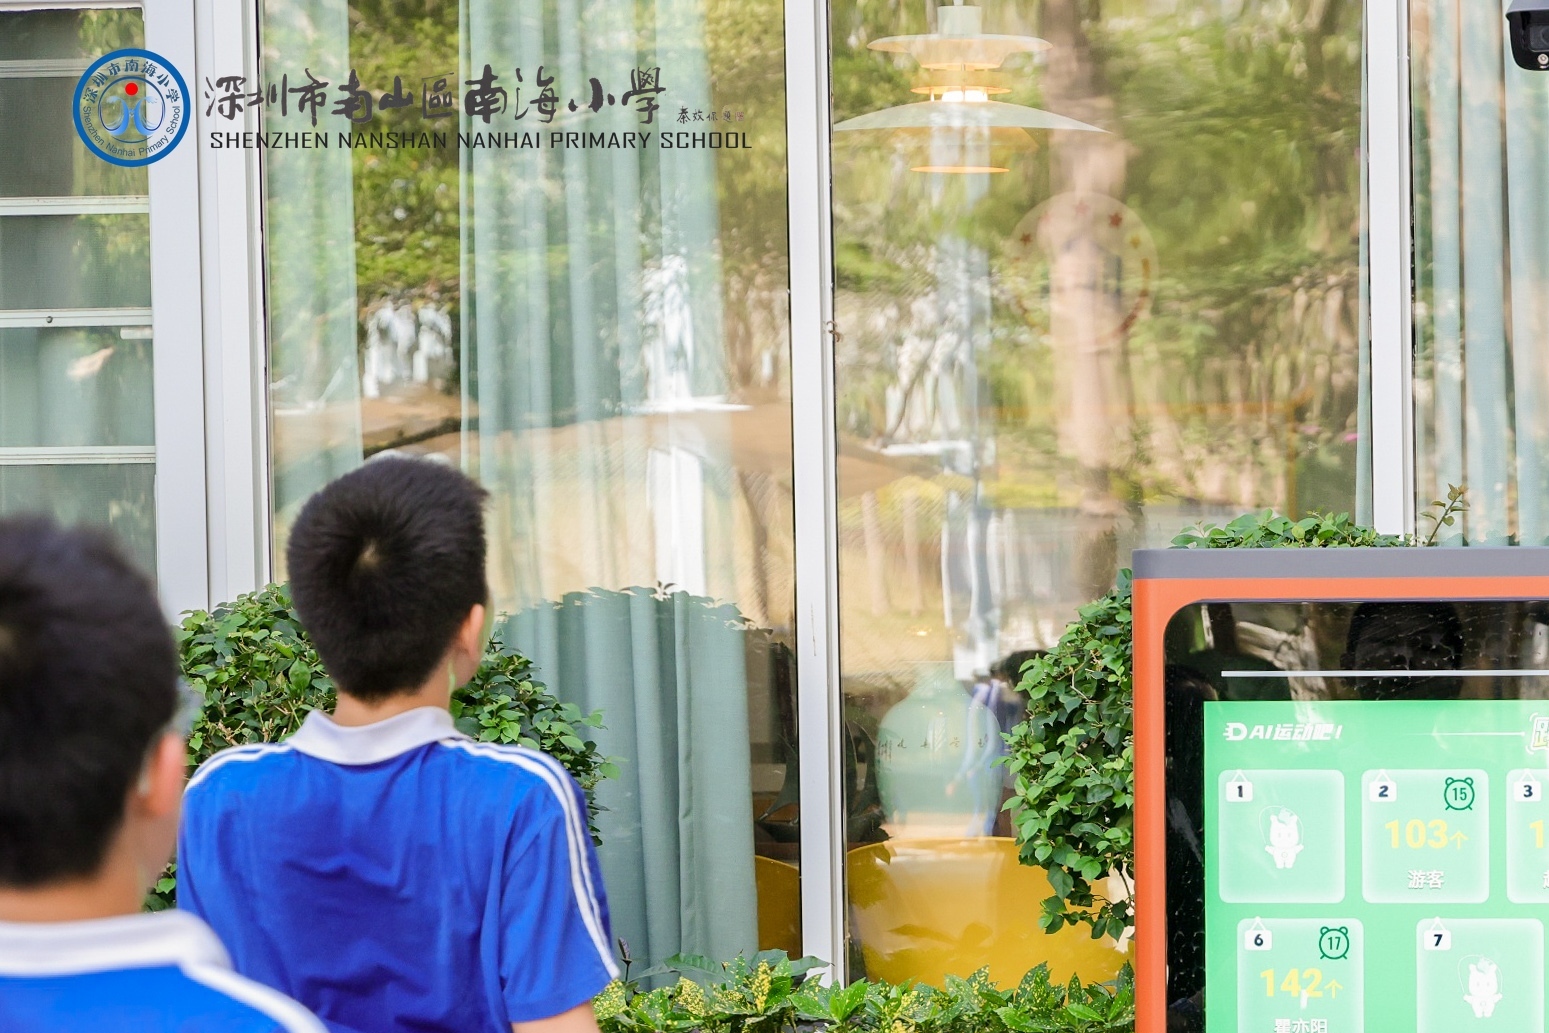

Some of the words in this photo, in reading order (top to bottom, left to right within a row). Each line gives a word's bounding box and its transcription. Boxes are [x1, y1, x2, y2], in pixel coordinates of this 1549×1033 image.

[1237, 785, 1244, 798] 1
[1378, 785, 1389, 798] 2
[1452, 787, 1468, 801] 15
[1523, 784, 1533, 798] 3
[1407, 869, 1445, 890] 游客
[1254, 933, 1264, 947] 6
[1327, 936, 1341, 951] 17
[1433, 934, 1443, 947] 7
